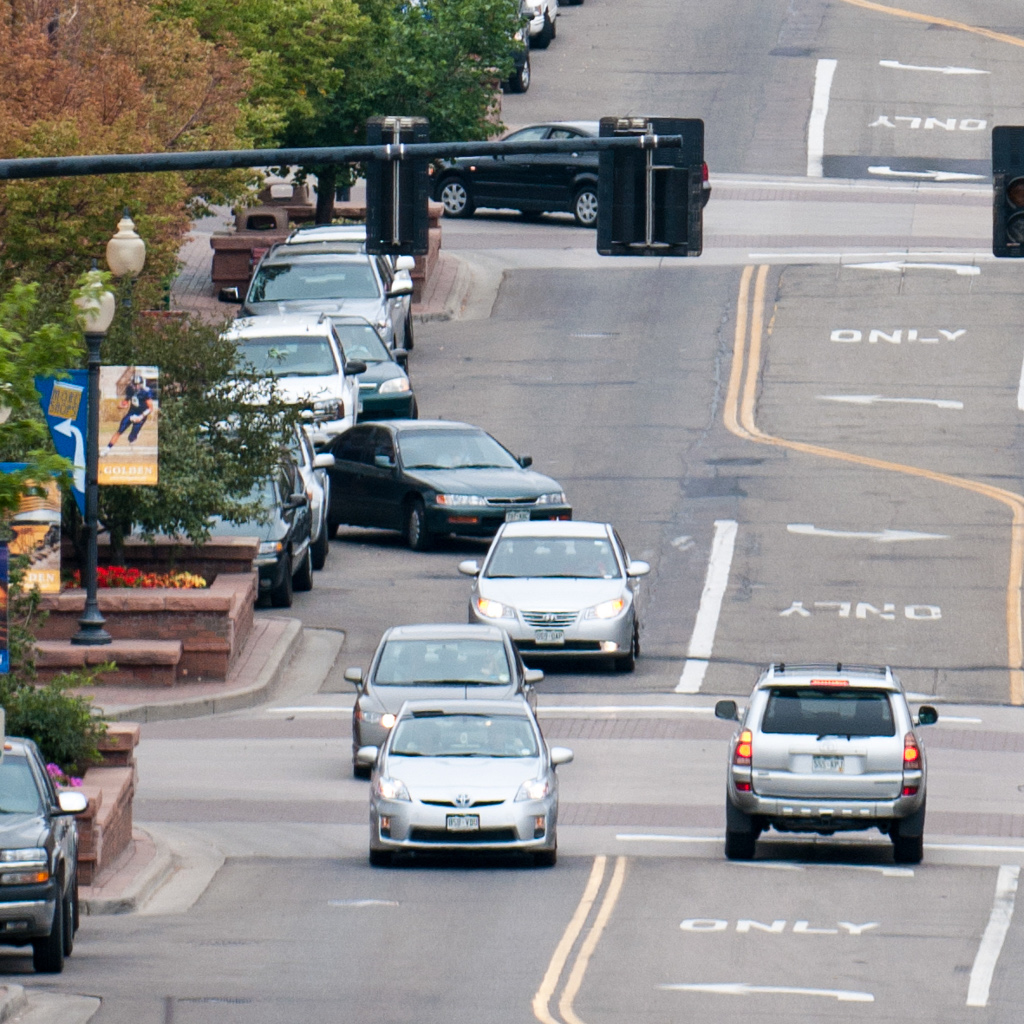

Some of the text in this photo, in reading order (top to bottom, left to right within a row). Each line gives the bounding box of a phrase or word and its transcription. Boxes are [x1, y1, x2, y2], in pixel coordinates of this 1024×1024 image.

[868, 115, 988, 131] ONLY
[830, 329, 967, 344] ONLY
[103, 465, 152, 475] GOLDEN
[779, 601, 943, 620] ONLY
[679, 919, 882, 935] ONLY
